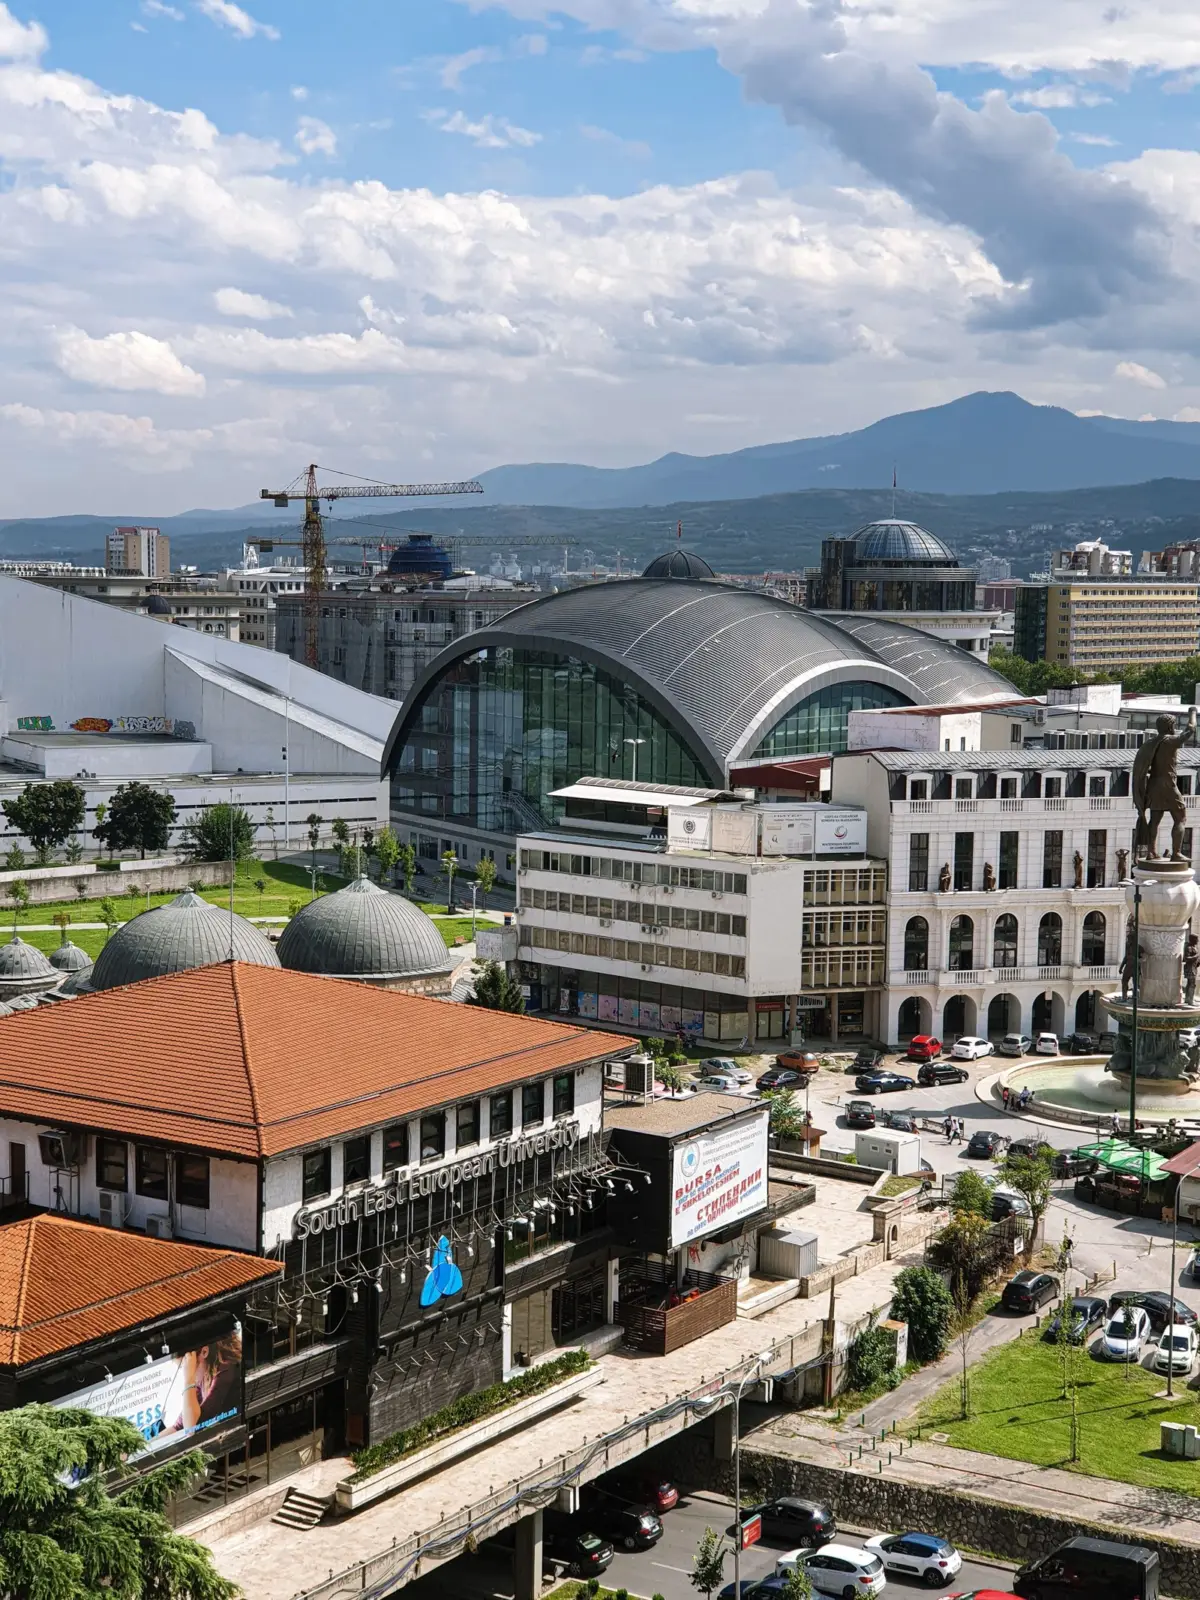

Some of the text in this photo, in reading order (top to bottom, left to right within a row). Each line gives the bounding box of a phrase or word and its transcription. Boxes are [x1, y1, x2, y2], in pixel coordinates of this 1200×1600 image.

[296, 1121, 579, 1240] South East European University
[675, 1164, 721, 1201] BURSA
[697, 1168, 762, 1221] СТИПЕНДИИ
[675, 1206, 681, 1216] E
